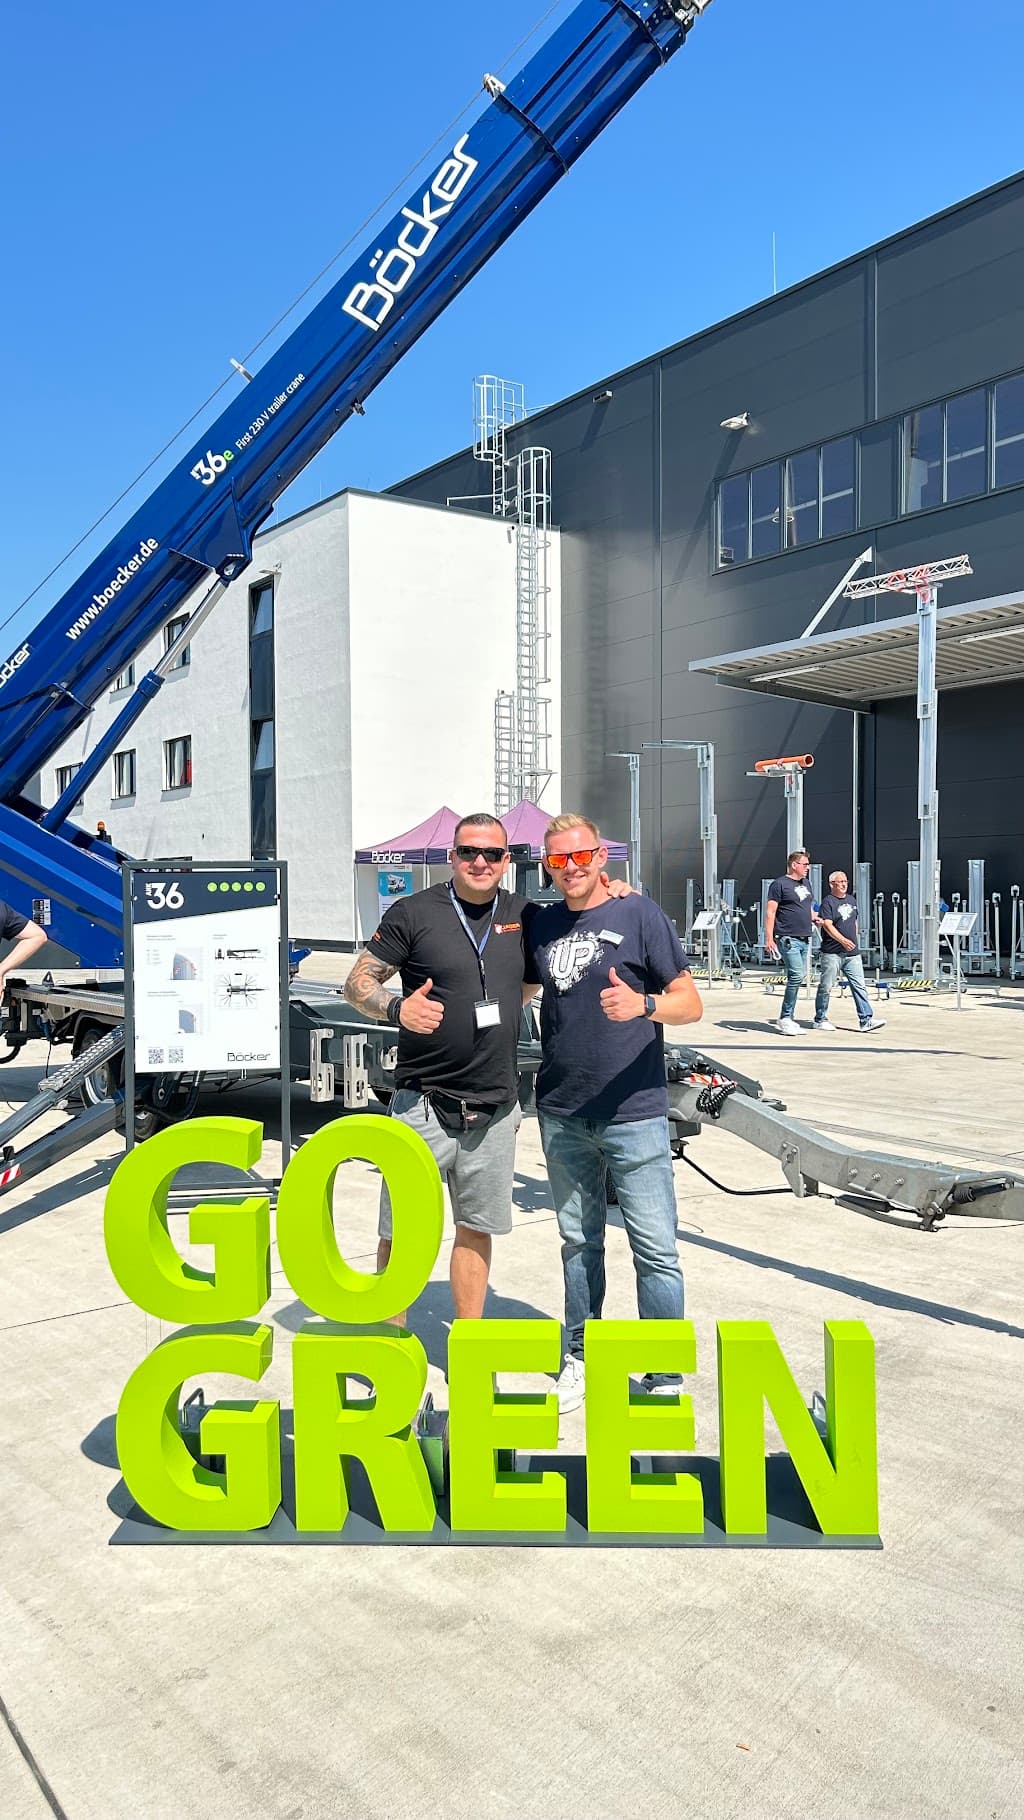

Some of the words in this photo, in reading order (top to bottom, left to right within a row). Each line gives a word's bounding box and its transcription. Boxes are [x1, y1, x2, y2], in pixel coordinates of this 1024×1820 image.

[341, 133, 479, 331] Böcker
[235, 431, 253, 450] First
[249, 417, 265, 435] 230
[261, 410, 270, 421] V
[267, 391, 288, 415] trailer
[286, 373, 306, 394] crane
[65, 537, 159, 641] www.boecker.de
[371, 849, 405, 864] Böcker
[147, 882, 184, 910] 36
[552, 940, 595, 980] UP
[227, 1051, 271, 1062] Böcker
[103, 1113, 445, 1325] GO
[116, 1318, 880, 1535] GREEN
